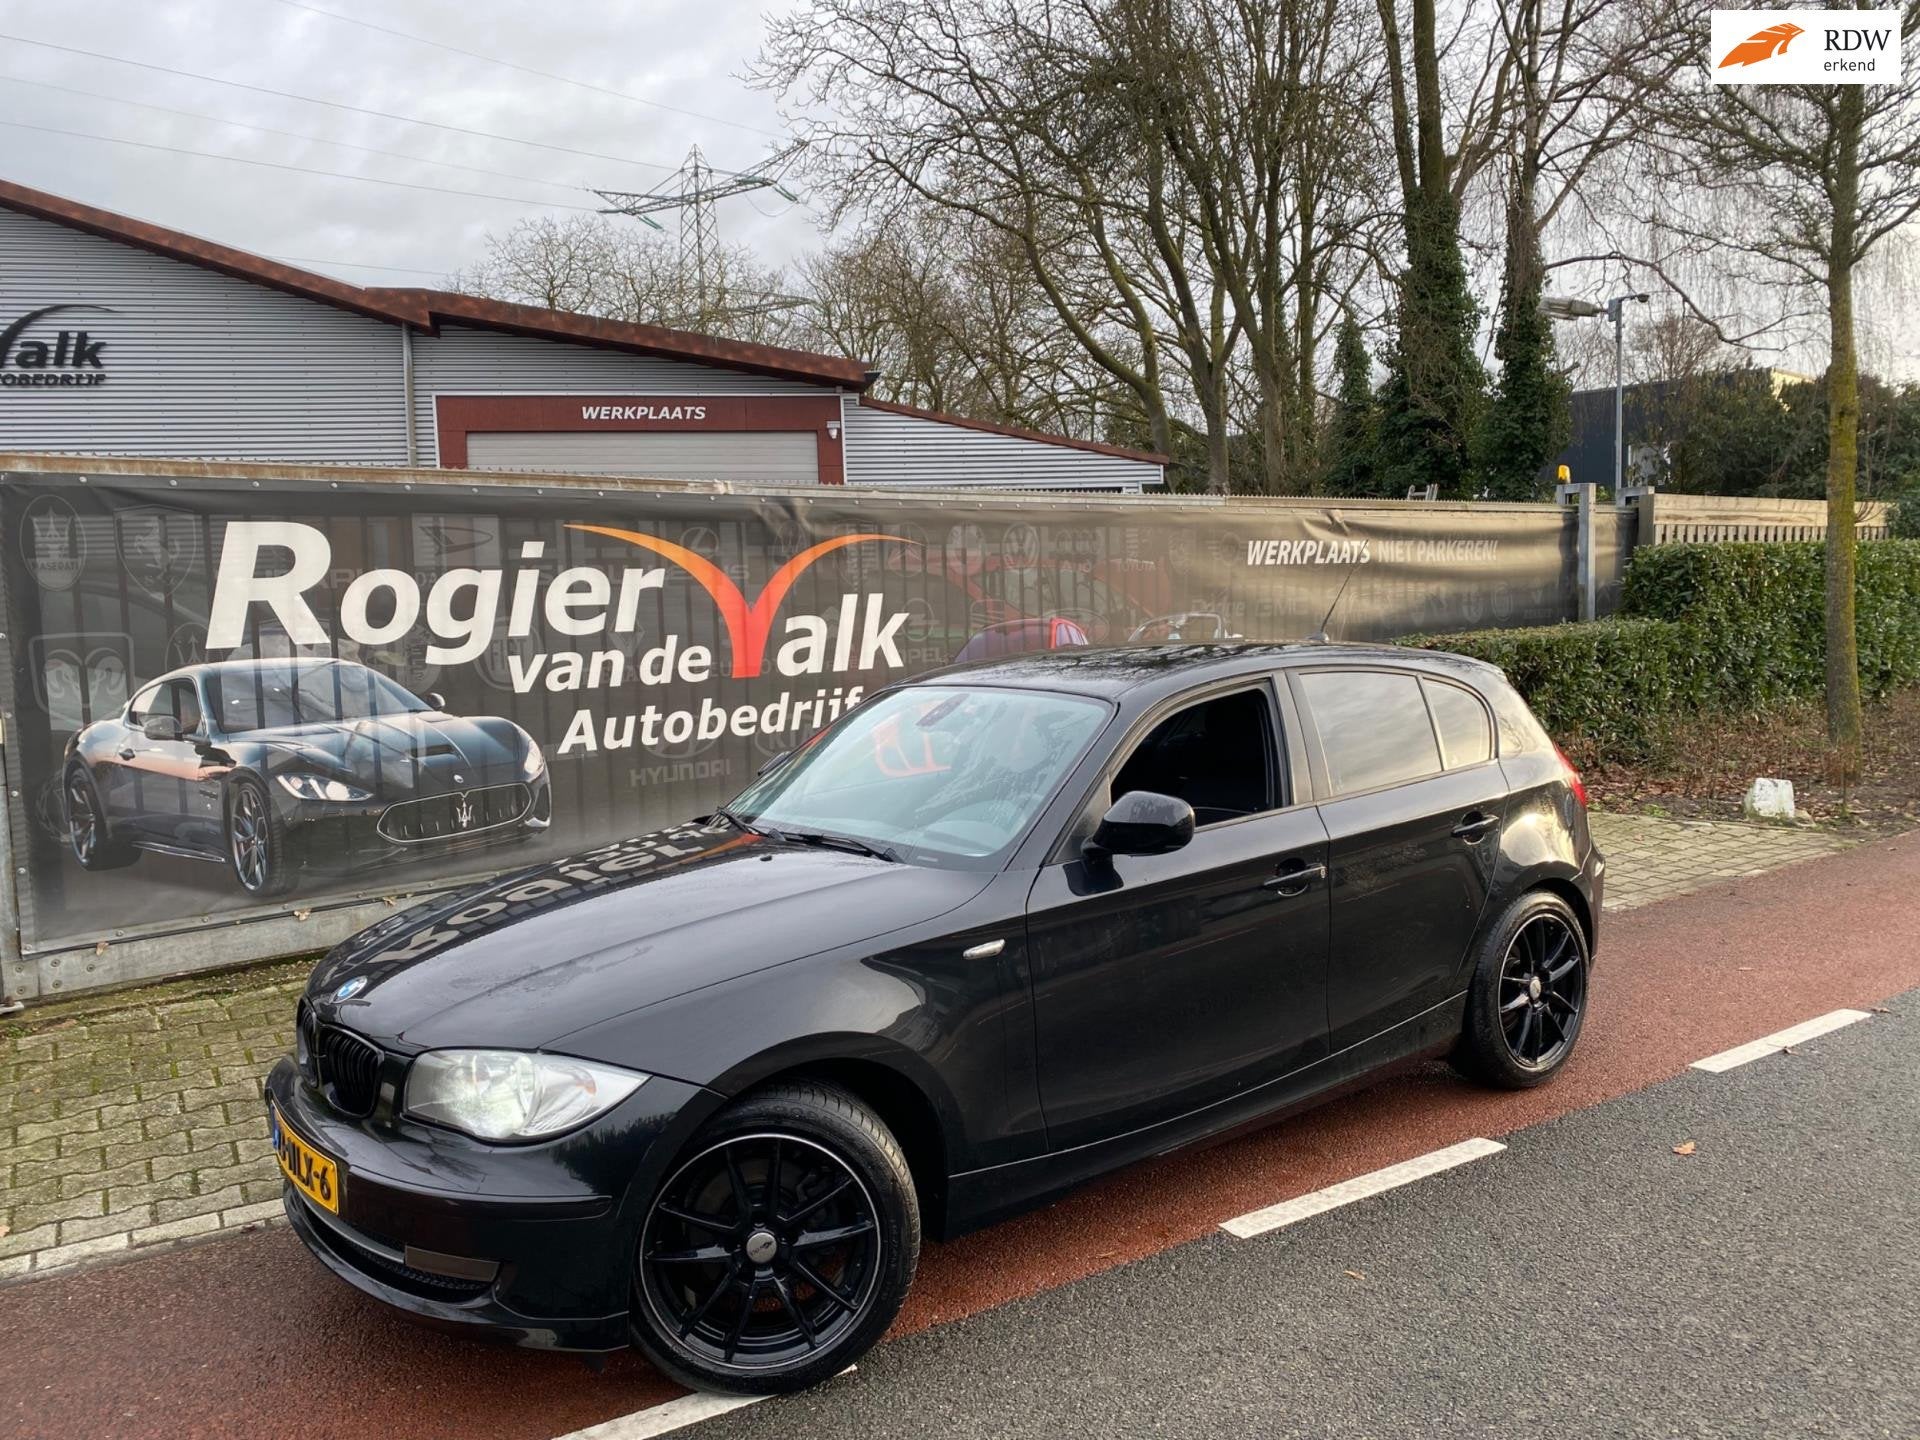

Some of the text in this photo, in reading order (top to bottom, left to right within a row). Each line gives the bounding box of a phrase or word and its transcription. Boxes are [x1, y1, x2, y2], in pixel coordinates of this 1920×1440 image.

[0, 373, 106, 386] OBEDRIJF
[581, 406, 706, 420] WERKPLAATS
[1247, 540, 1499, 566] WERKPLAATS NIET PARKEREN!
[205, 521, 666, 665] Rogier
[507, 650, 626, 693] van
[639, 635, 712, 686] de
[557, 686, 864, 754] Autobedrijf
